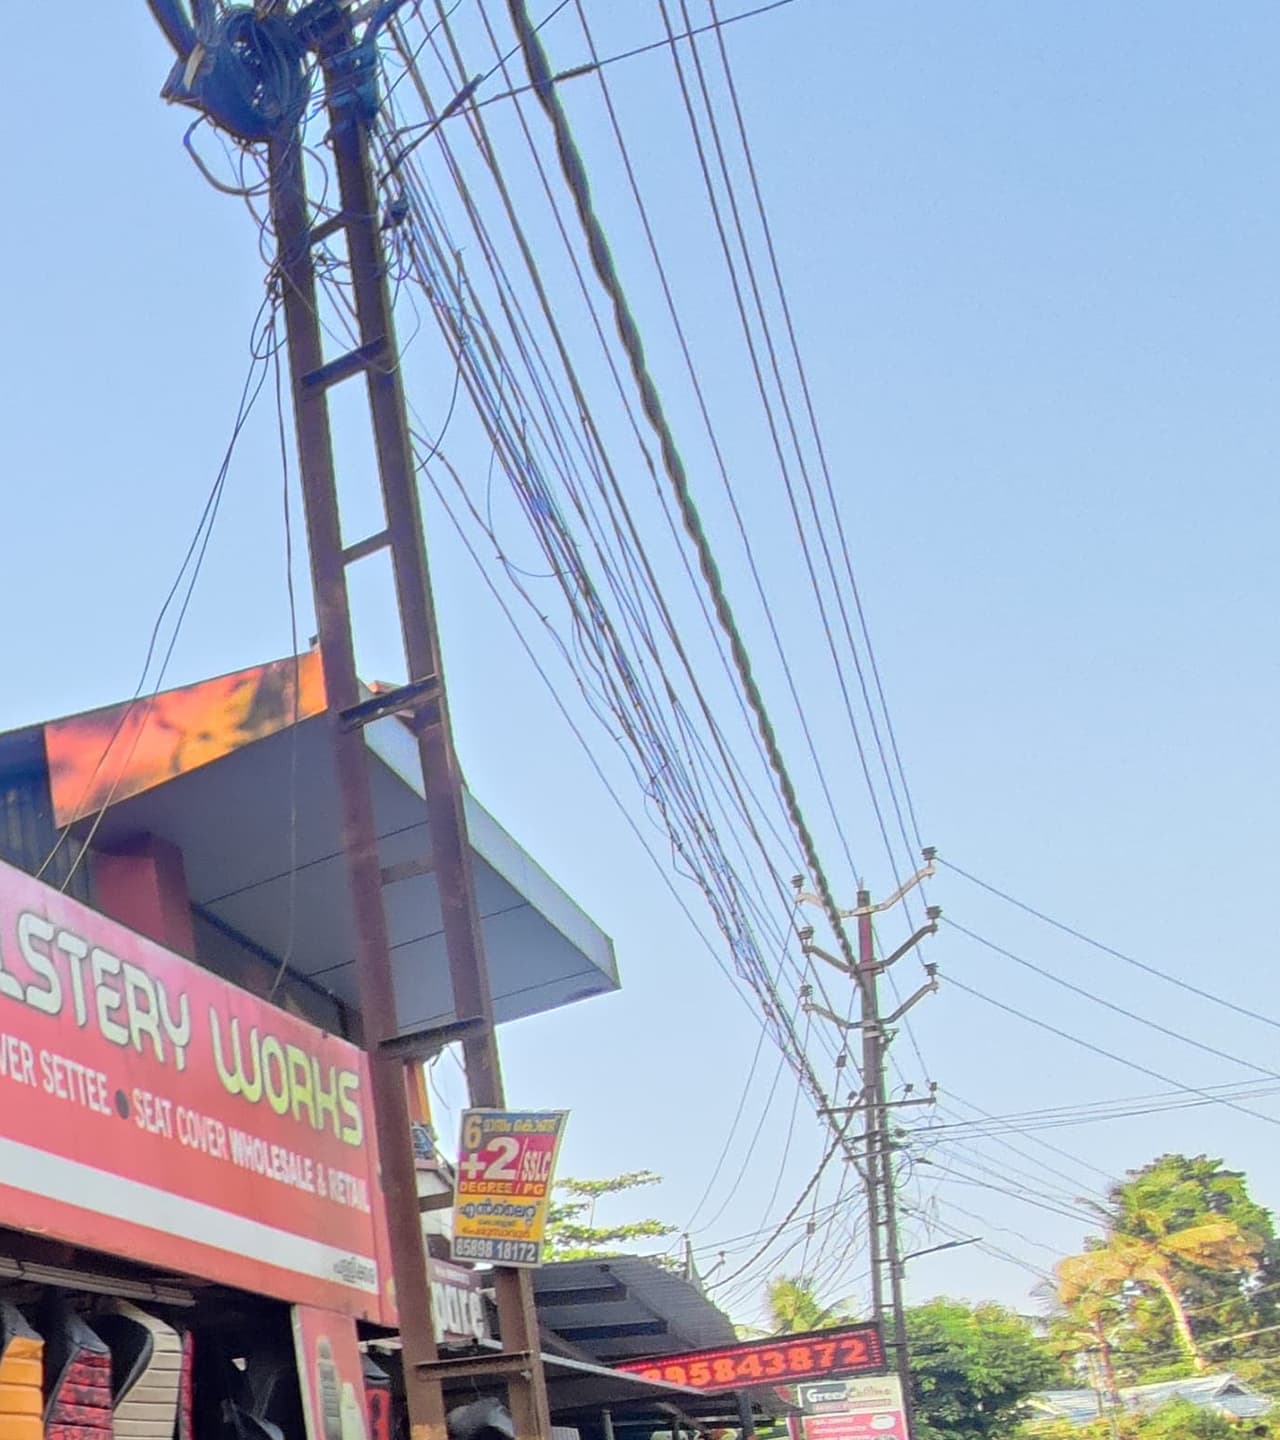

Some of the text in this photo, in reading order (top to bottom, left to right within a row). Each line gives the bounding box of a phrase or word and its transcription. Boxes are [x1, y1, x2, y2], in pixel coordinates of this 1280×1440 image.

[39, 1049, 113, 1117] SETTEE
[210, 1005, 364, 1147] WORKS
[131, 1087, 173, 1140] SEAT
[176, 1105, 230, 1161] COVER
[229, 1126, 316, 1194] WHOLESALE
[328, 1167, 371, 1215] RETAIL
[463, 1115, 482, 1150] 6
[459, 1181, 513, 1194] DEGREE
[523, 1184, 545, 1195] PG
[497, 1242, 536, 1262] 18172
